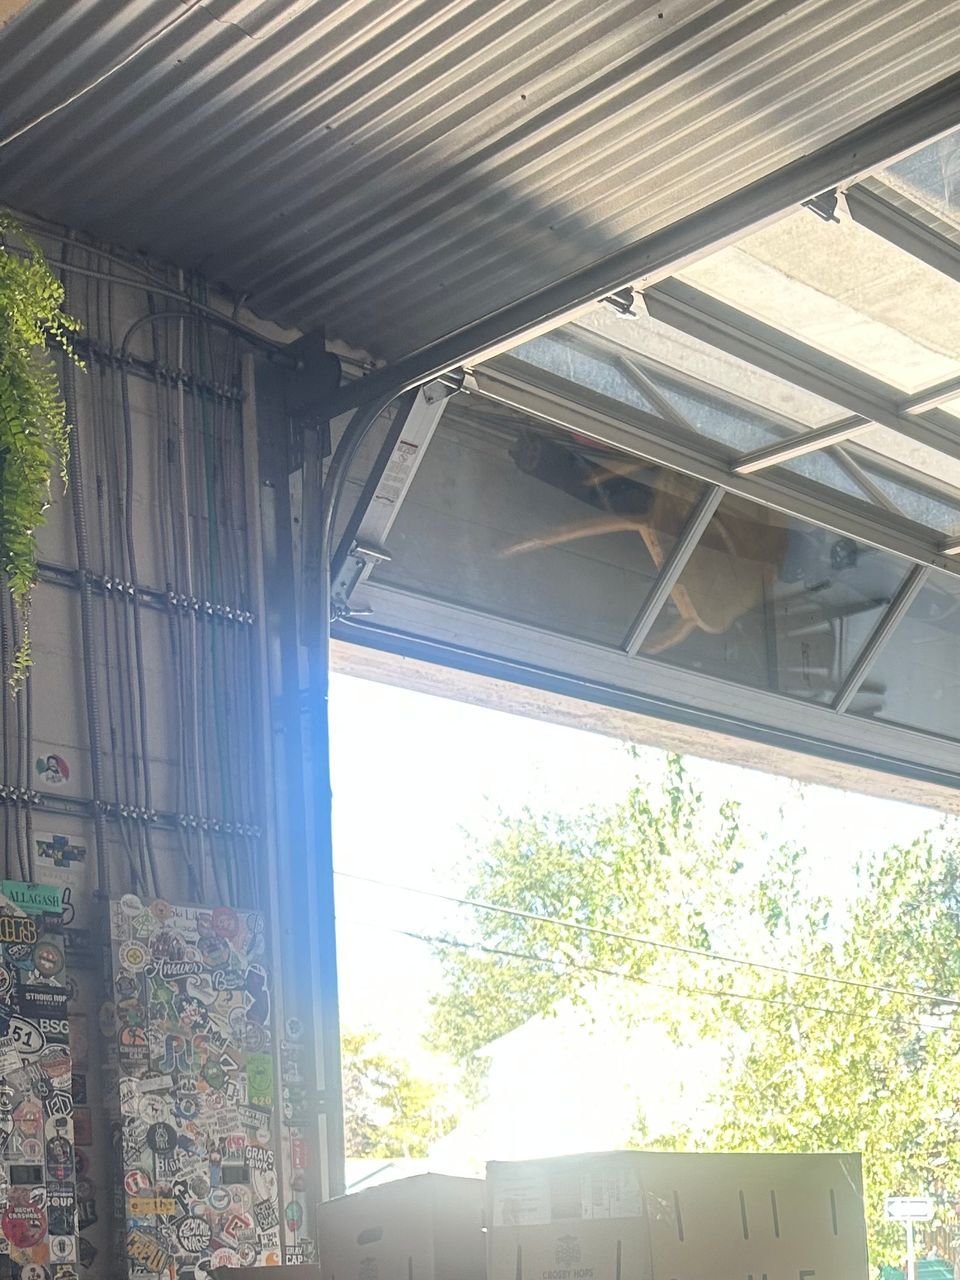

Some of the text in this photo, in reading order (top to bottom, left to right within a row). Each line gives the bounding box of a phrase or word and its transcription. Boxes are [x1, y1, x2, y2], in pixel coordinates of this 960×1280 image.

[9, 889, 59, 908] ALLAGASH
[144, 957, 203, 985] Answer
[40, 1019, 69, 1034] BSG
[251, 1095, 272, 1105] 420
[46, 1196, 74, 1208] SOUP
[542, 1267, 594, 1280] CROSBY HOPS
